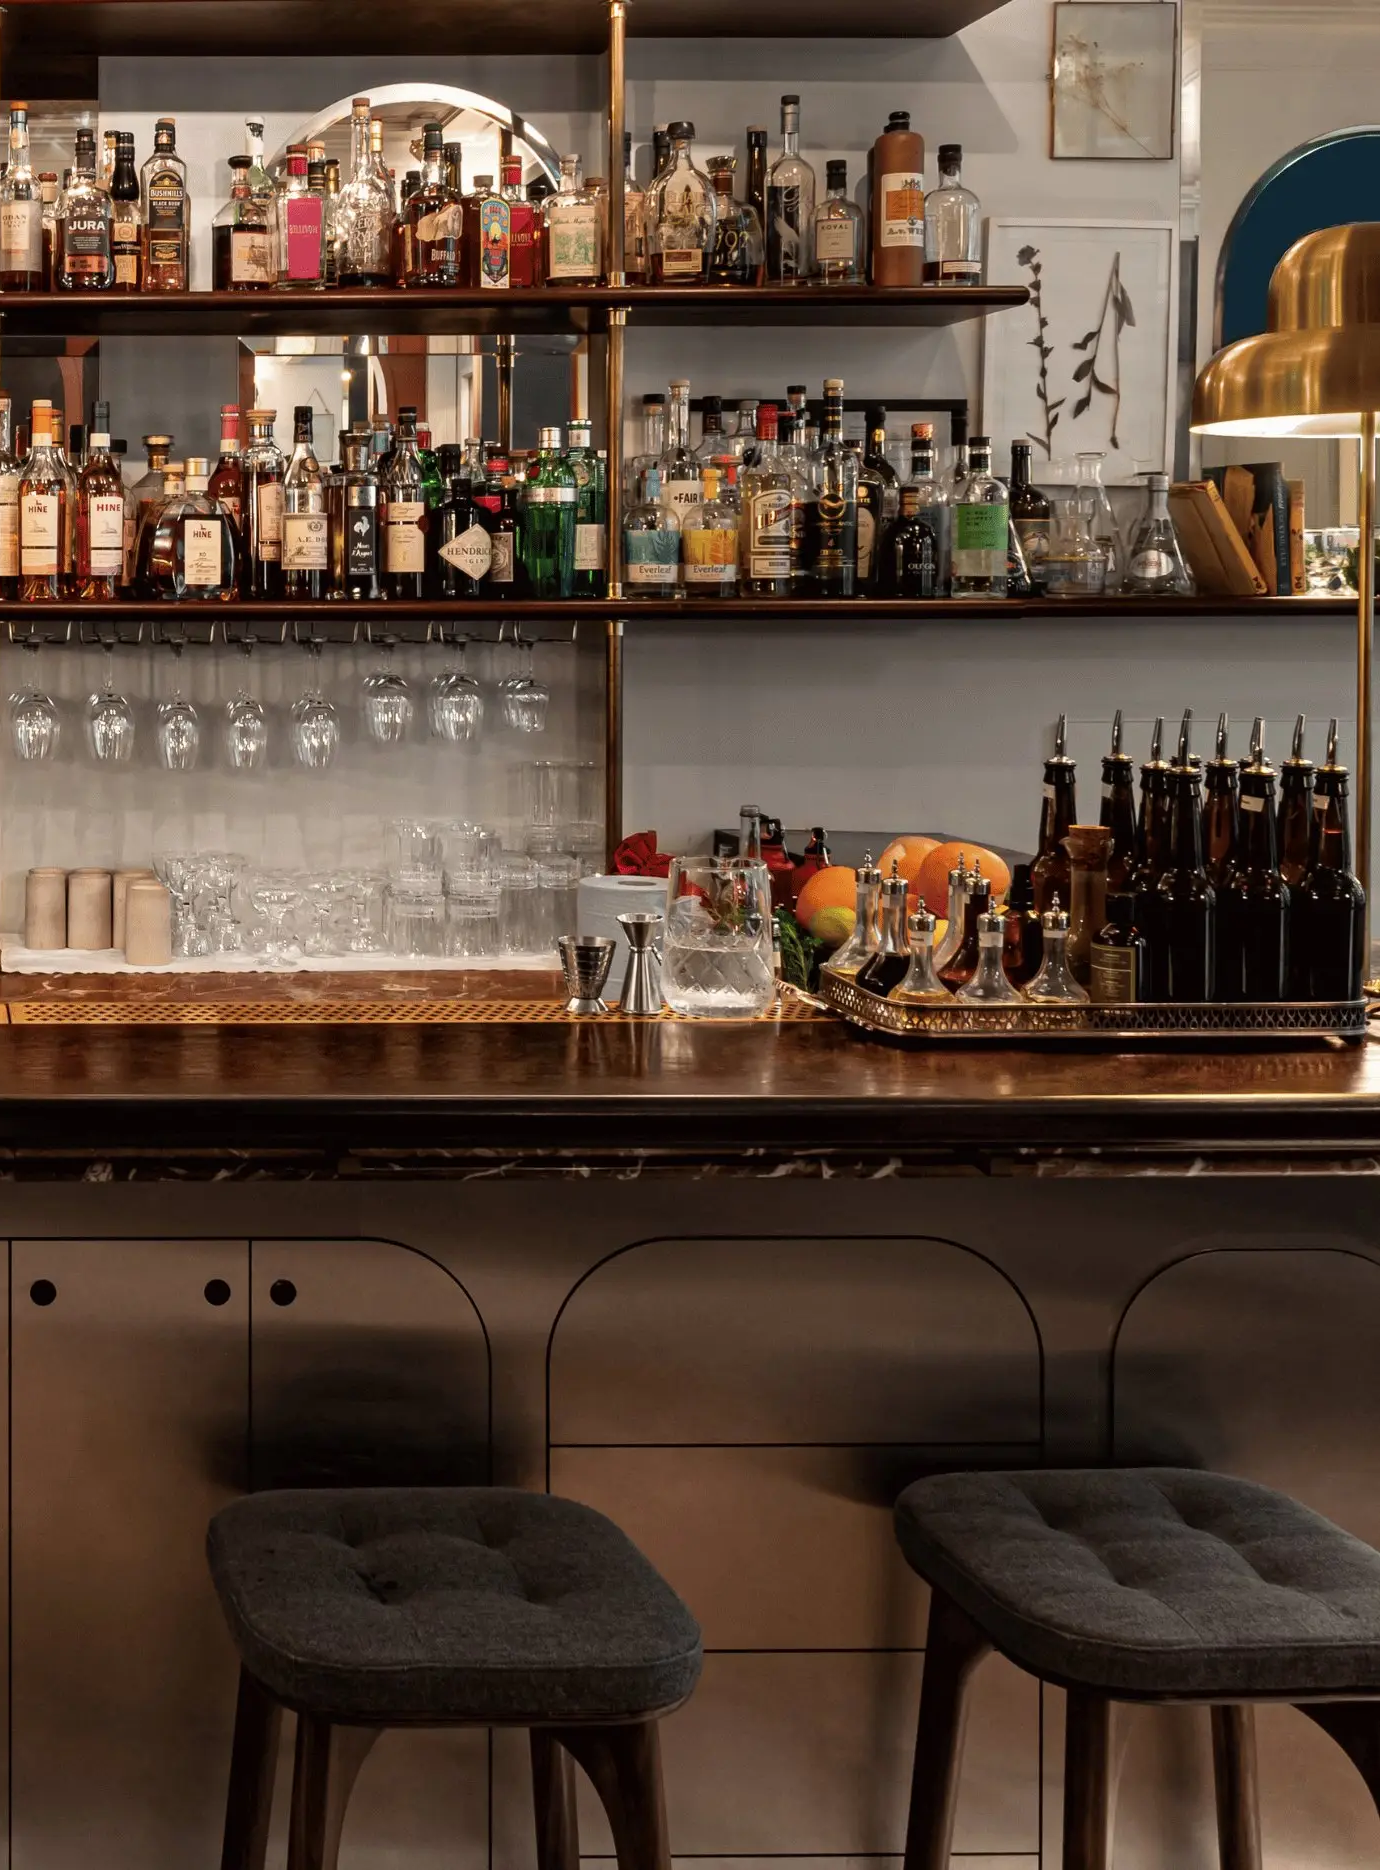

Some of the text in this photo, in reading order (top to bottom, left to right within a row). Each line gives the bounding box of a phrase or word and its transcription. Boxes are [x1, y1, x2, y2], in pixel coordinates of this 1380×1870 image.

[150, 189, 183, 197] BUSHMILLS
[68, 220, 105, 230] JURA
[431, 249, 456, 261] BUFFALO
[678, 493, 698, 504] FAIR
[28, 505, 48, 513] HINE
[96, 503, 121, 512] HINE
[639, 565, 672, 574] Everleaf
[694, 564, 727, 574] Everleaf
